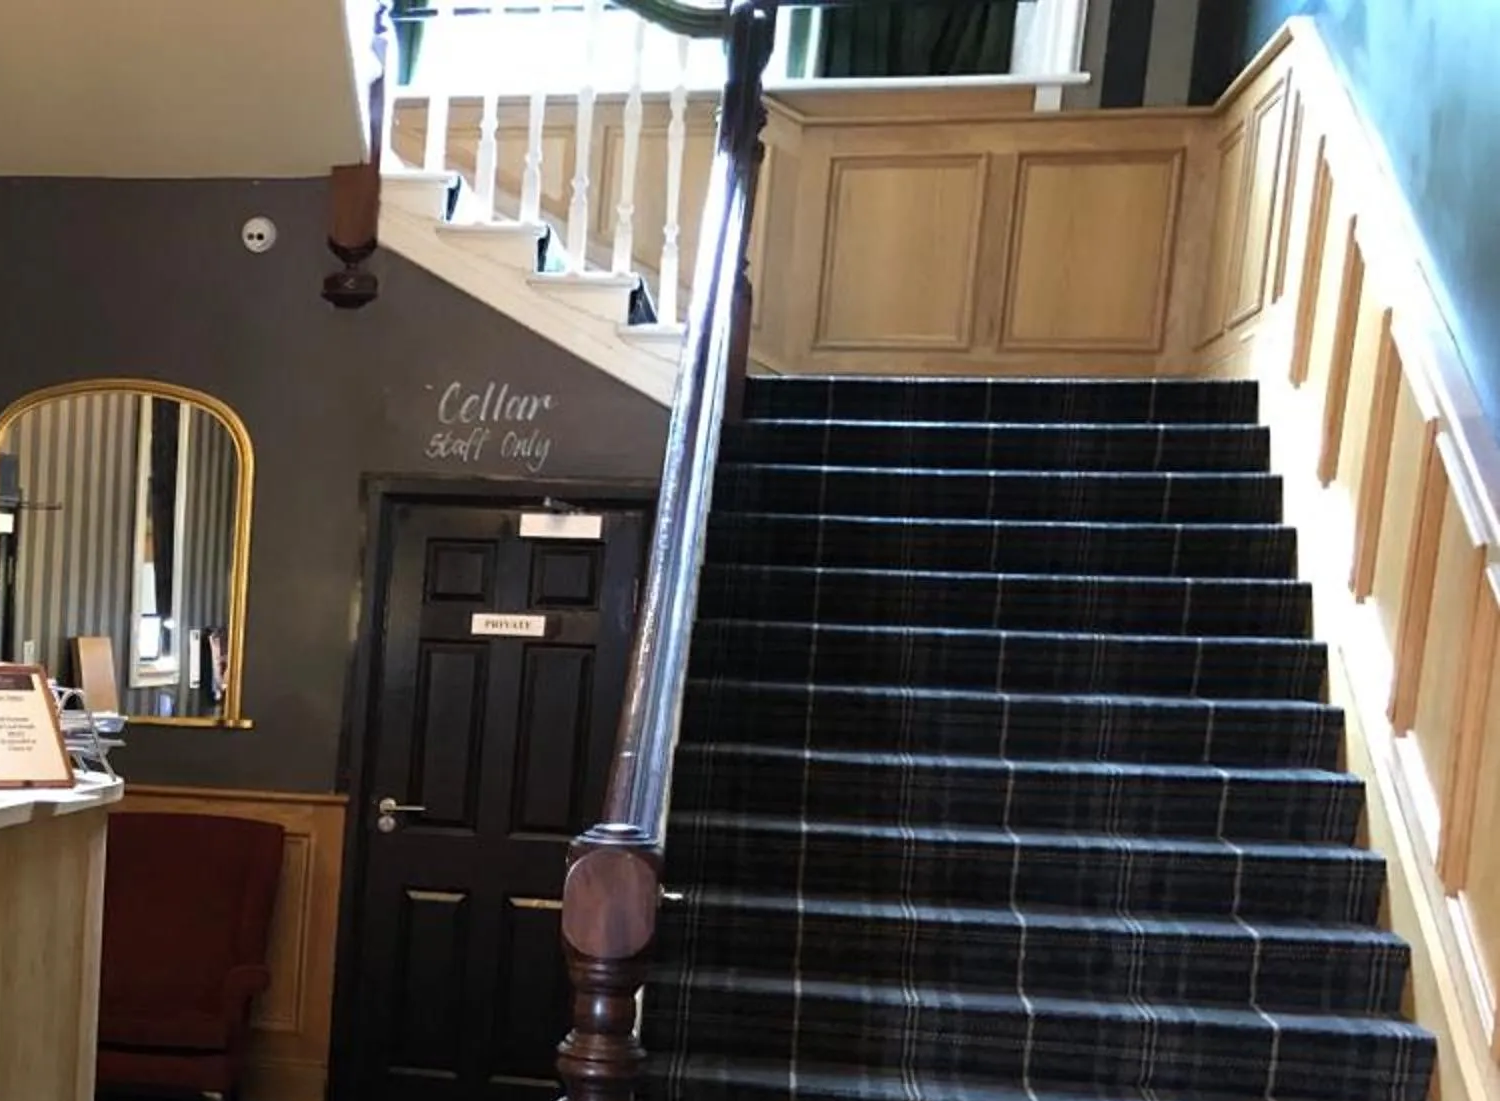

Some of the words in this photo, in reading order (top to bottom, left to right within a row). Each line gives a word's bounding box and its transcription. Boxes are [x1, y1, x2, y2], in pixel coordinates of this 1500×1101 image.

[438, 381, 553, 424] Cellar
[425, 427, 490, 461] Staff
[500, 429, 550, 473] Only
